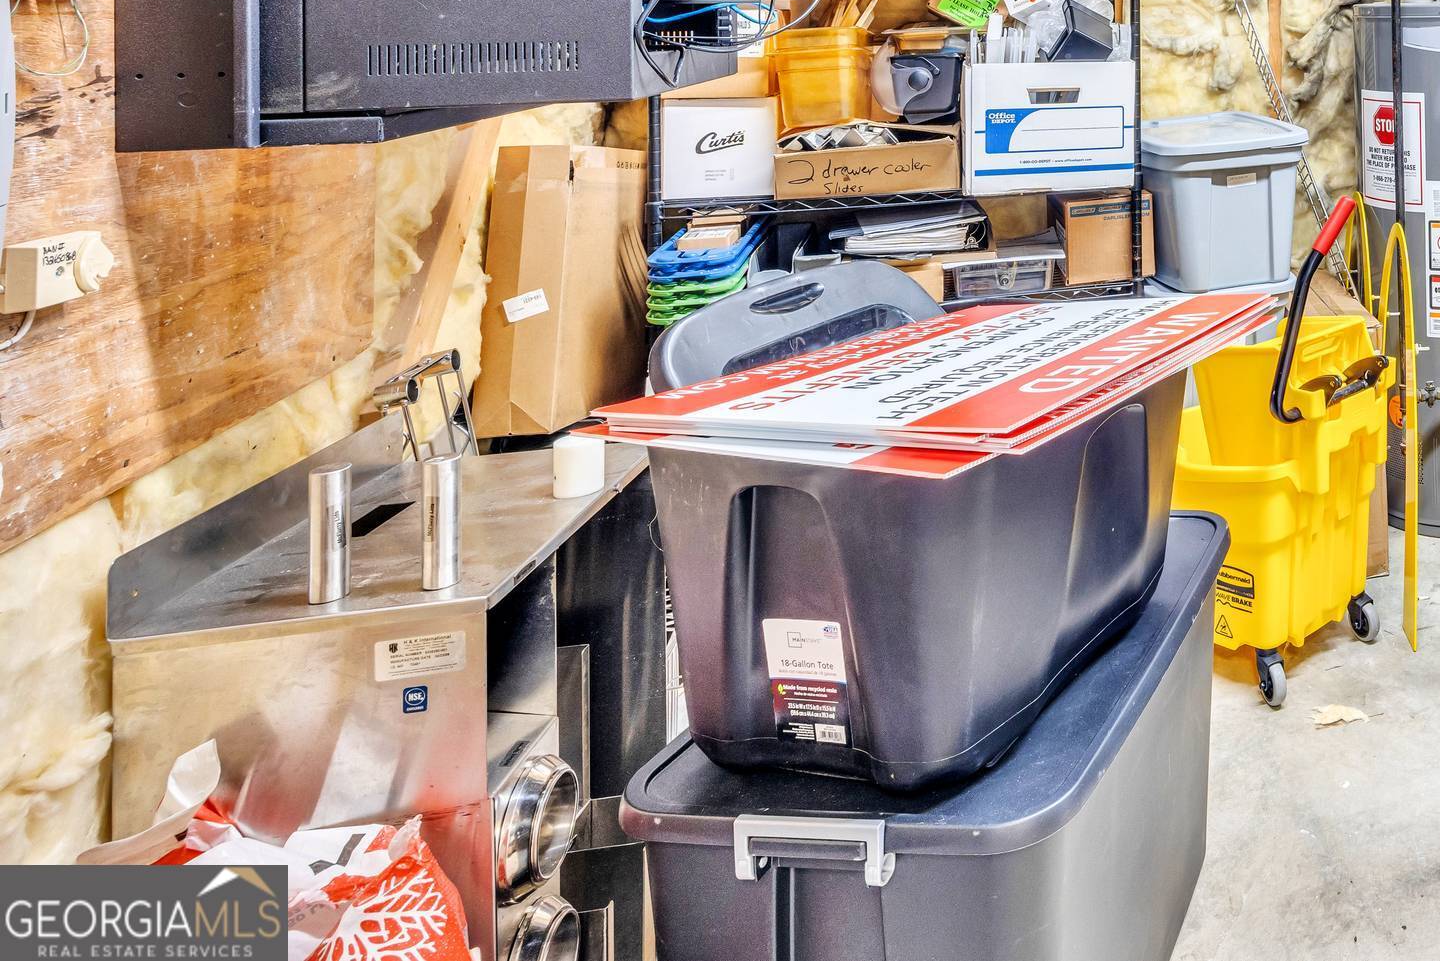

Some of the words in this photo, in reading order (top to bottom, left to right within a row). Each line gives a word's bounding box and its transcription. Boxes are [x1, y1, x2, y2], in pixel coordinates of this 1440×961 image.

[988, 112, 1016, 120] Office
[695, 131, 745, 155] Curtis
[787, 159, 814, 184] 2
[822, 159, 880, 179] drawer
[883, 158, 932, 174] cooler
[1000, 308, 1133, 352] EXPERIENCE
[840, 317, 1057, 389] COMPENSATION
[1018, 311, 1220, 393] WANTED
[727, 351, 935, 411] BENEFITS
[877, 354, 1020, 404] REQUIRED
[876, 389, 972, 420] TECH
[1231, 597, 1252, 607] BRAKE
[781, 659, 816, 669] 18-Gallon
[817, 662, 834, 670] Tote
